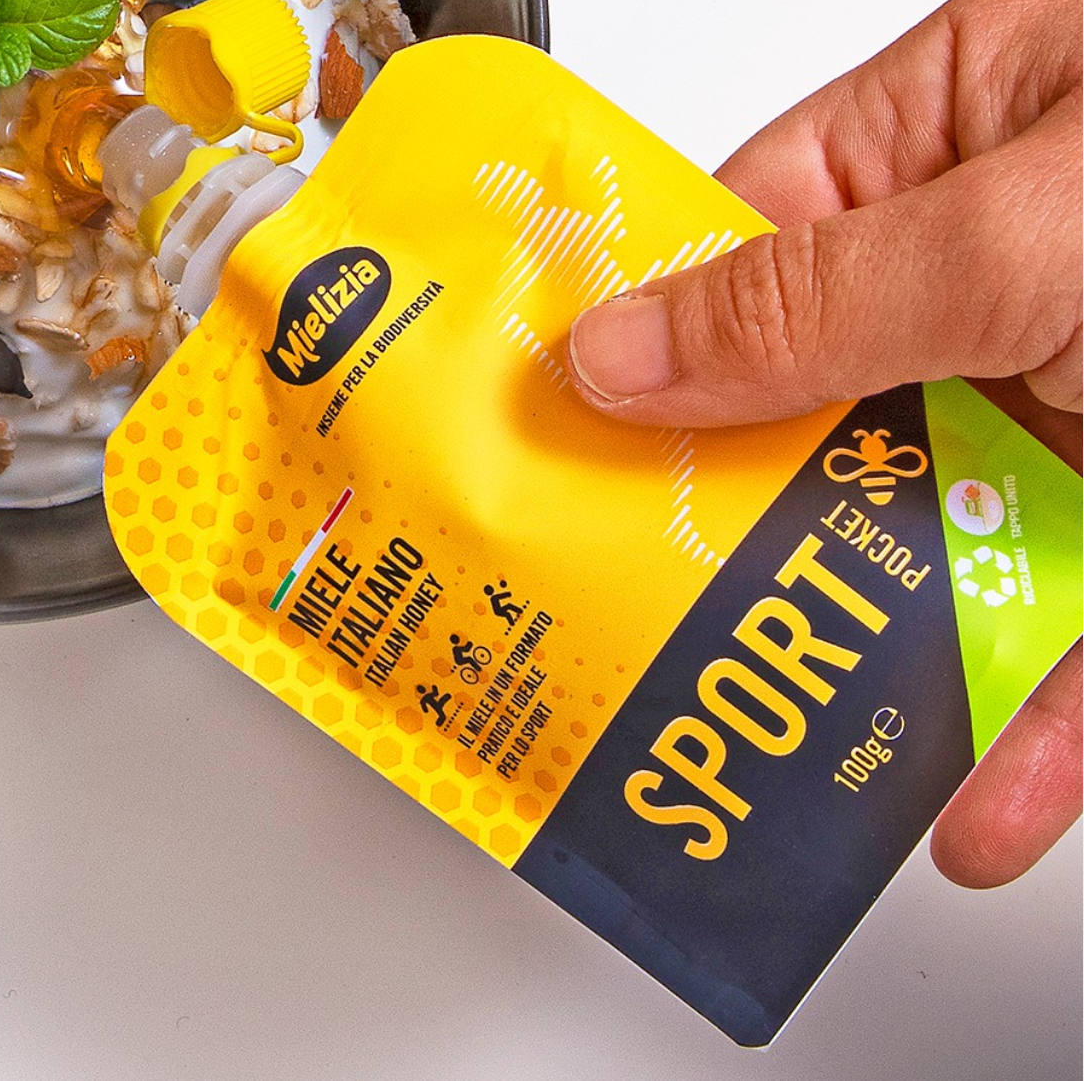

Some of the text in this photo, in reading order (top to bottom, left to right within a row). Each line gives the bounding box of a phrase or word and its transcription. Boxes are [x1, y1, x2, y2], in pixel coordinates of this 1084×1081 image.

[277, 259, 381, 378] Mielizia
[316, 281, 445, 437] INSIEME PER LA BIODIVERSITÀ
[287, 543, 362, 639] MIELE
[326, 537, 424, 669] ITALIANO
[820, 500, 932, 592] POCKET
[365, 572, 444, 688] ITALIAN HONEY
[457, 610, 553, 749] IL MIELE IN UN FORMATO
[477, 665, 547, 764] PRATICO E IDEALE
[496, 700, 553, 779] PER LO SPORT
[623, 532, 891, 861] SPORT
